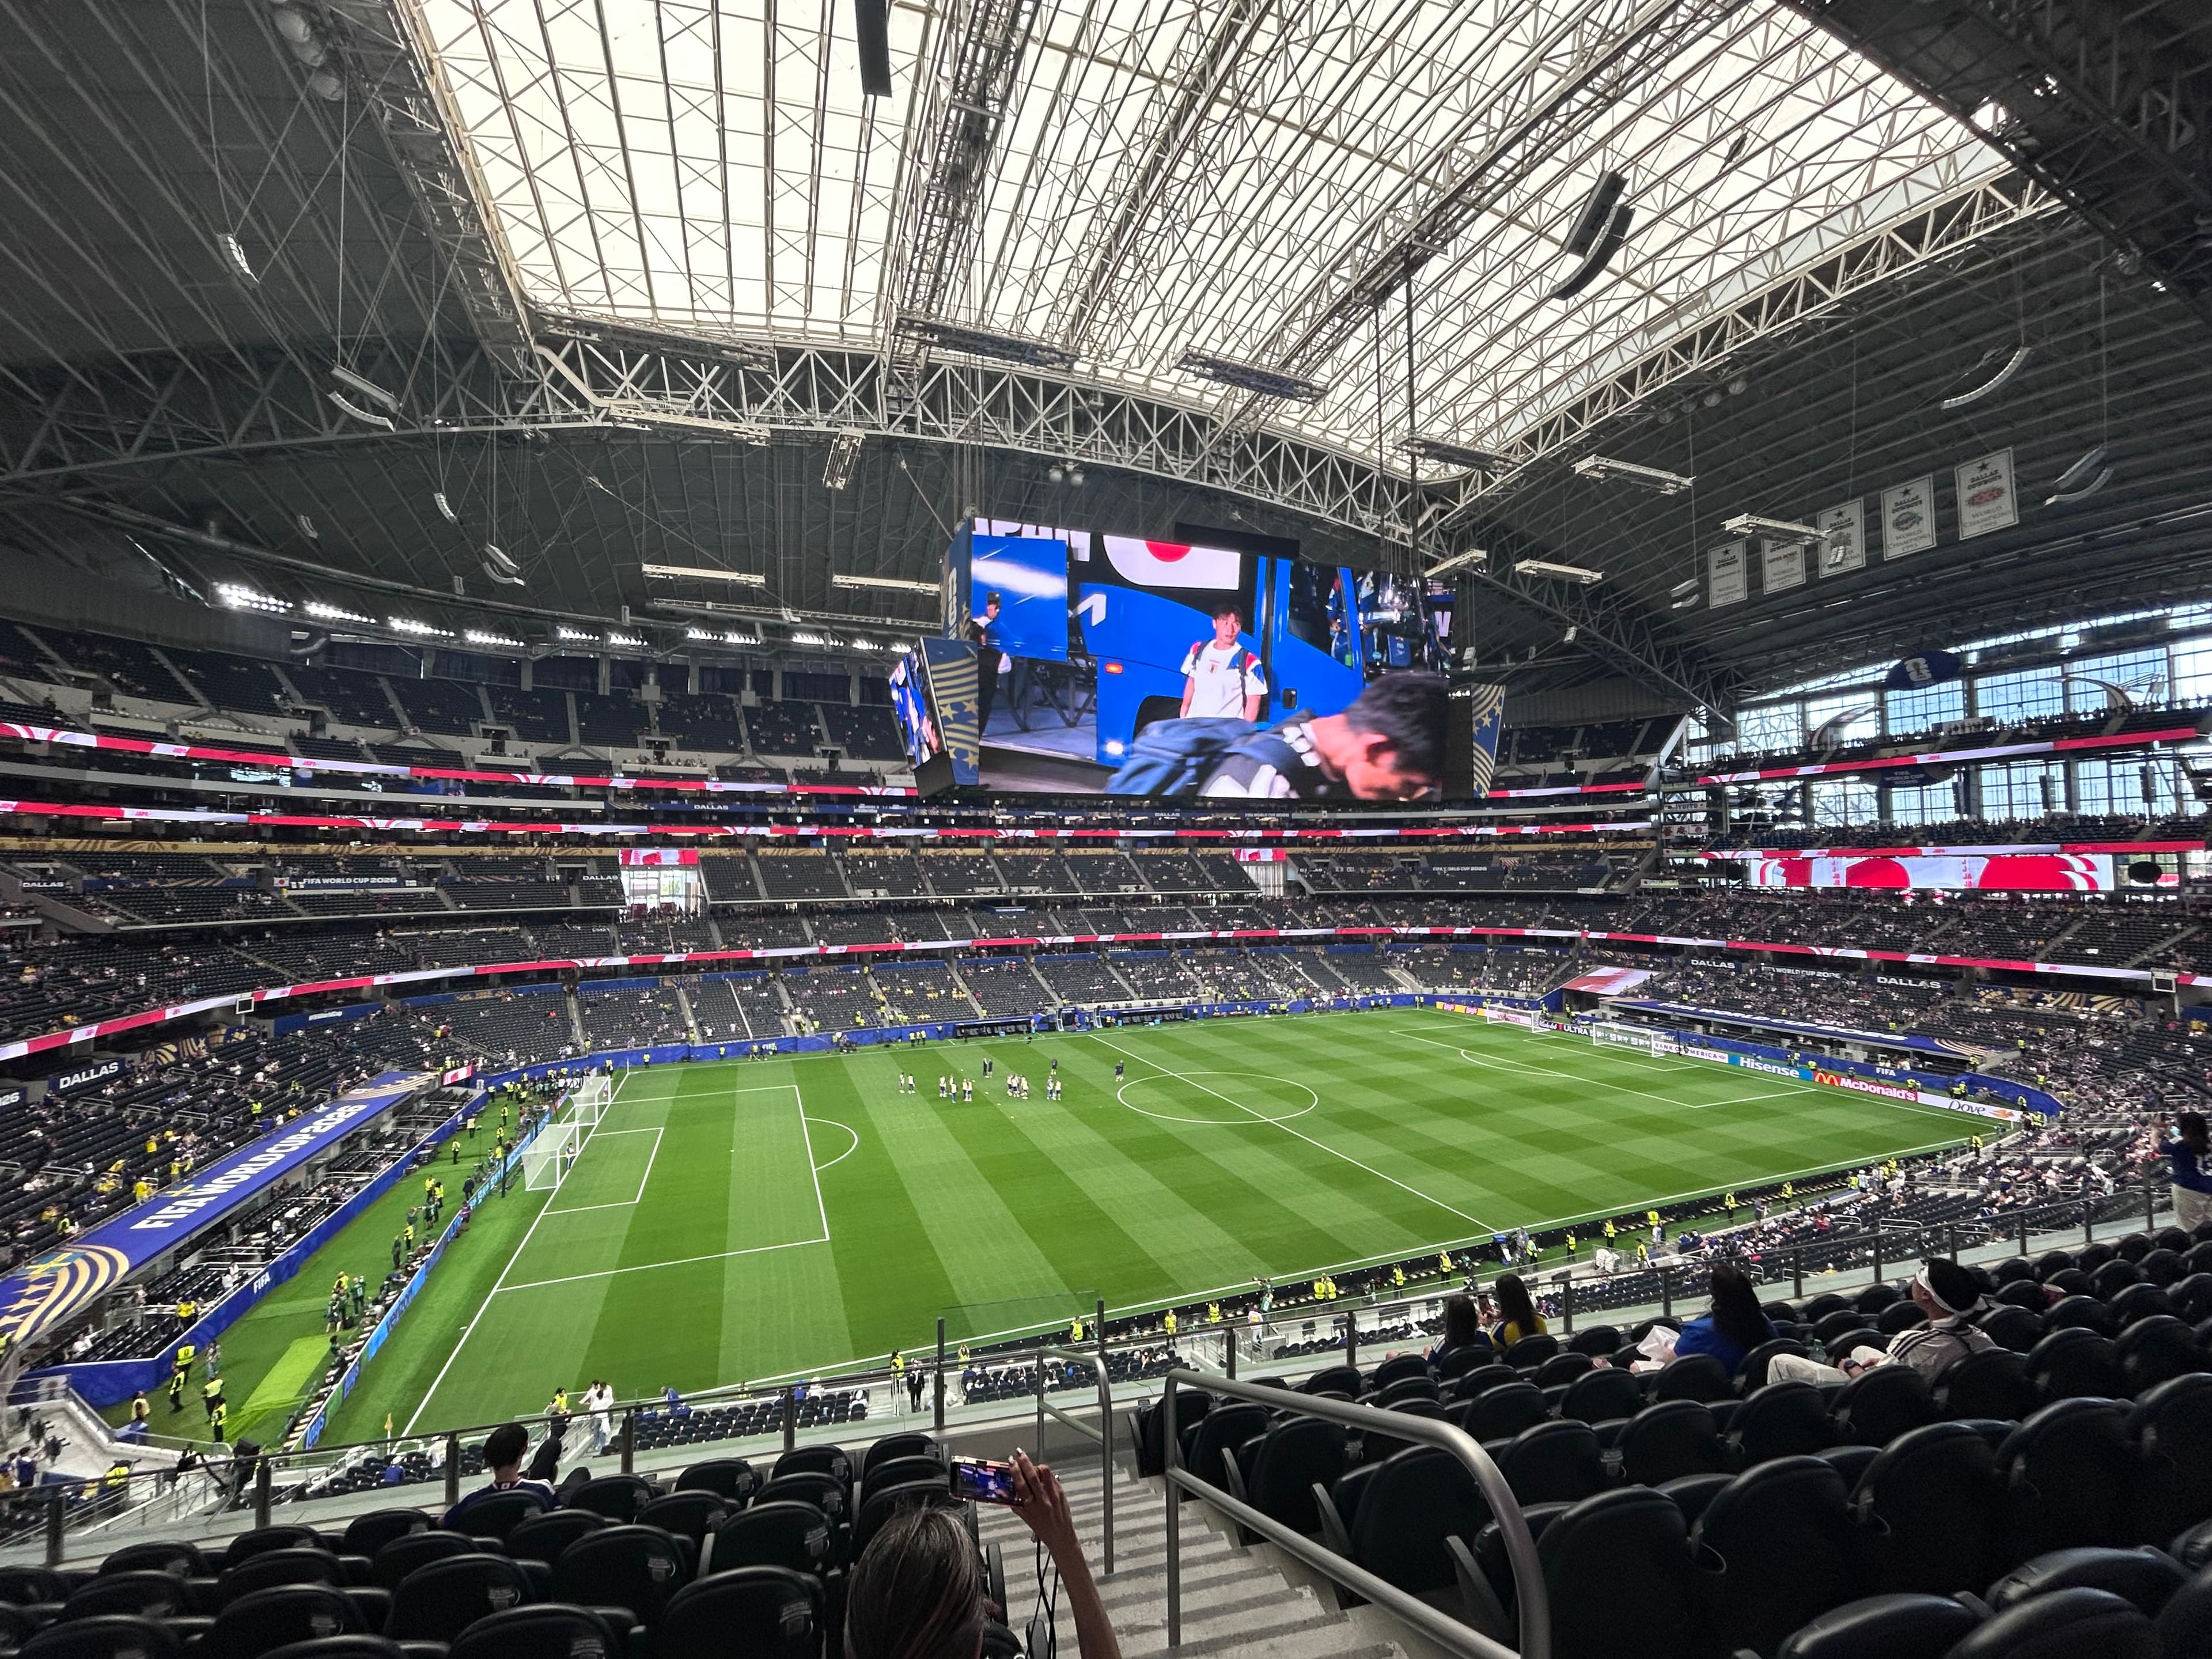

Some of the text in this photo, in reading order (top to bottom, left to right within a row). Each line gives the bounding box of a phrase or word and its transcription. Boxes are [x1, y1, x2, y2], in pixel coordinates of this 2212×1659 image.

[1691, 959, 1735, 969] DALLAS
[1877, 976, 1941, 989] DALLAS
[1563, 1025, 1589, 1036] ULTRA
[1658, 1001, 1908, 1041] FIFA WORLD CUP 2026
[1655, 1043, 1673, 1051] BANK
[59, 1062, 119, 1089] DALLAS
[1740, 1056, 1800, 1078] Hisense
[1876, 1067, 1896, 1077] FIFA
[1840, 1077, 1916, 1102] McDonald's
[1948, 1100, 1986, 1116] Dove
[130, 1104, 368, 1229] FIFA WORLD CUP 2026
[253, 1272, 271, 1294] FIFA
